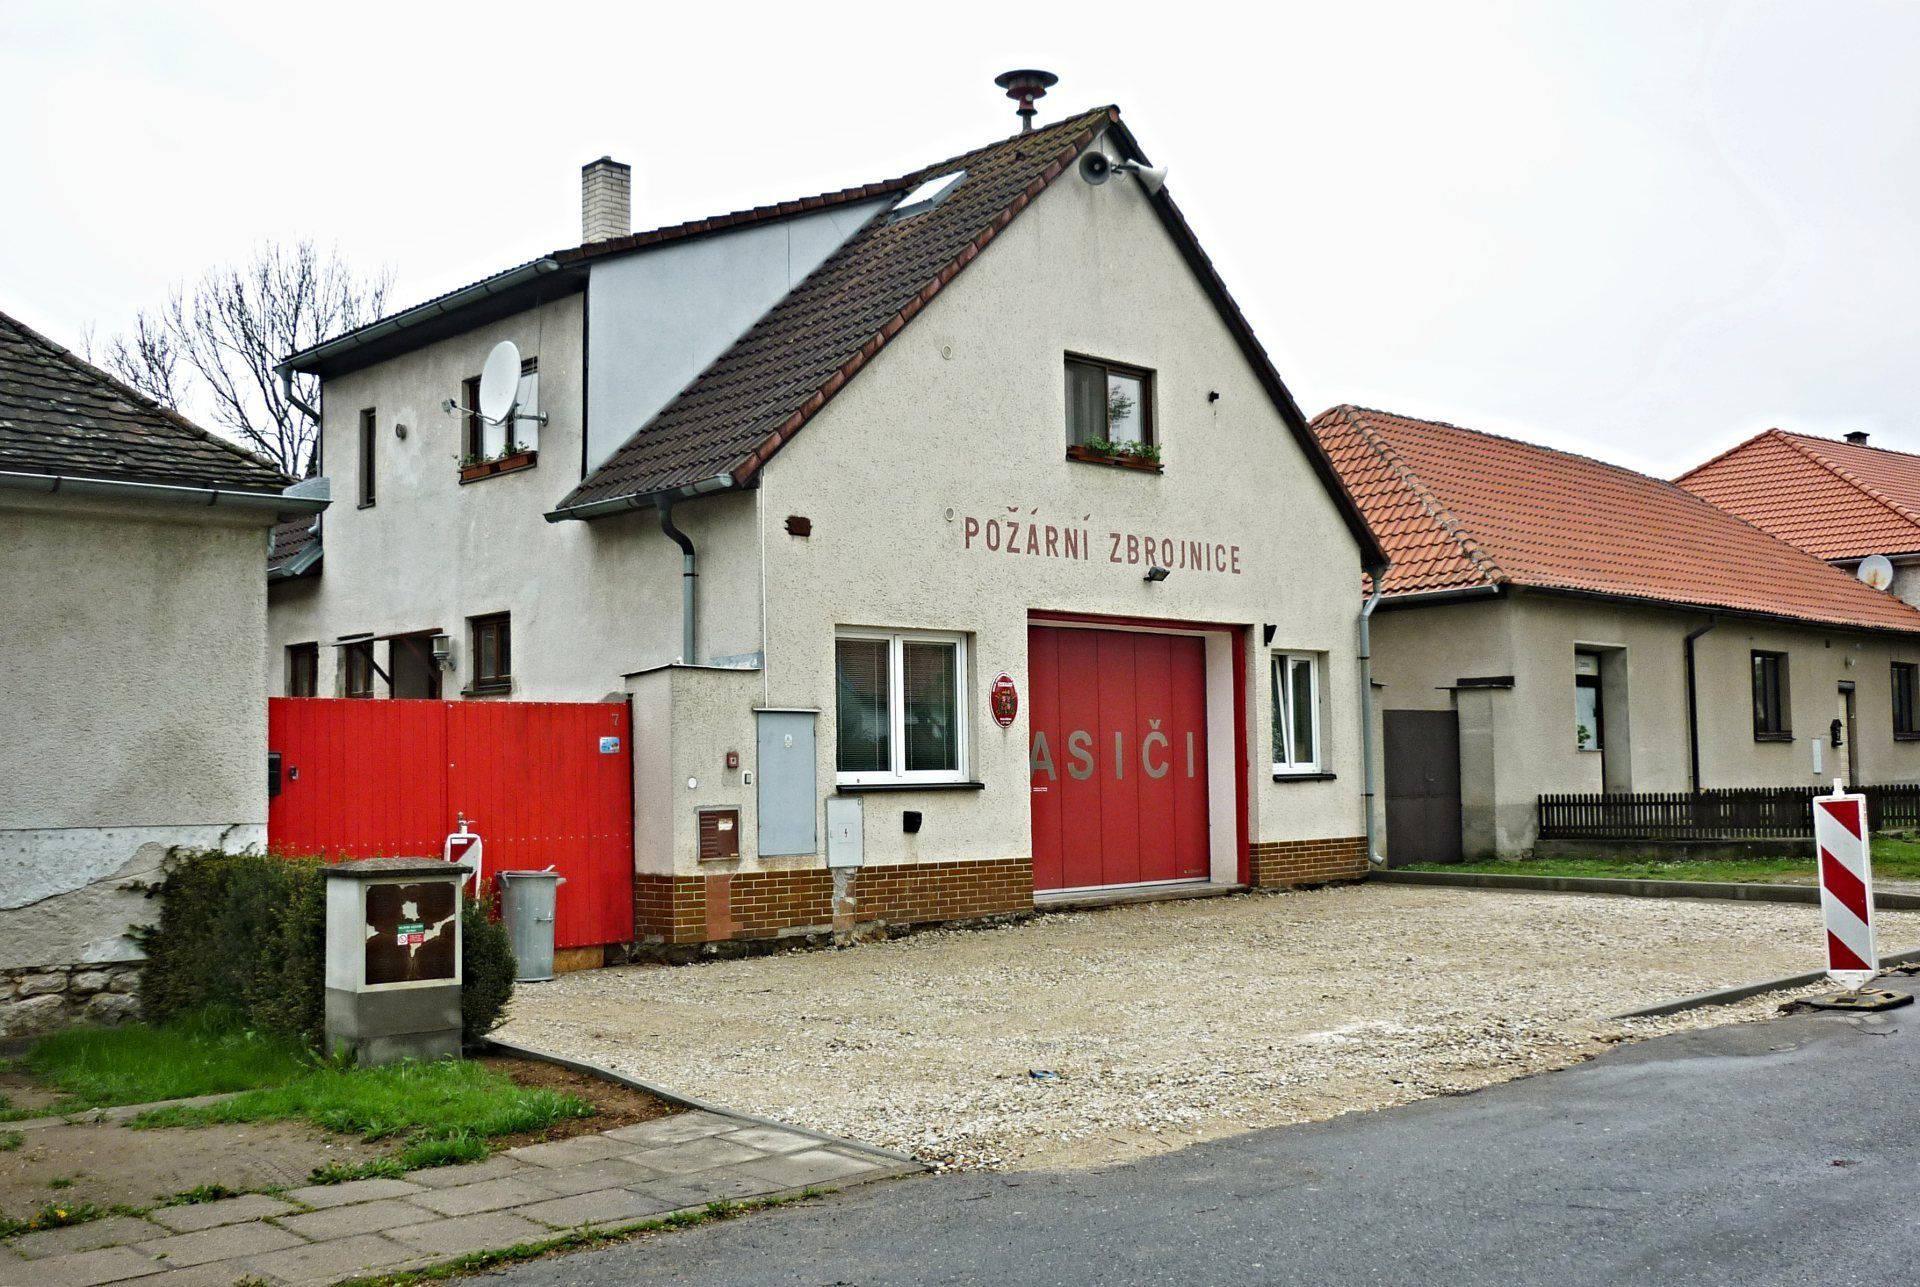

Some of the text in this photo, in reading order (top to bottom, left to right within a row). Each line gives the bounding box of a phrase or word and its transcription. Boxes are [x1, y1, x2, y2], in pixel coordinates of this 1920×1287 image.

[965, 505, 1242, 575] POŽÁRNÍ ZBROJNICE
[611, 712, 620, 727] 7
